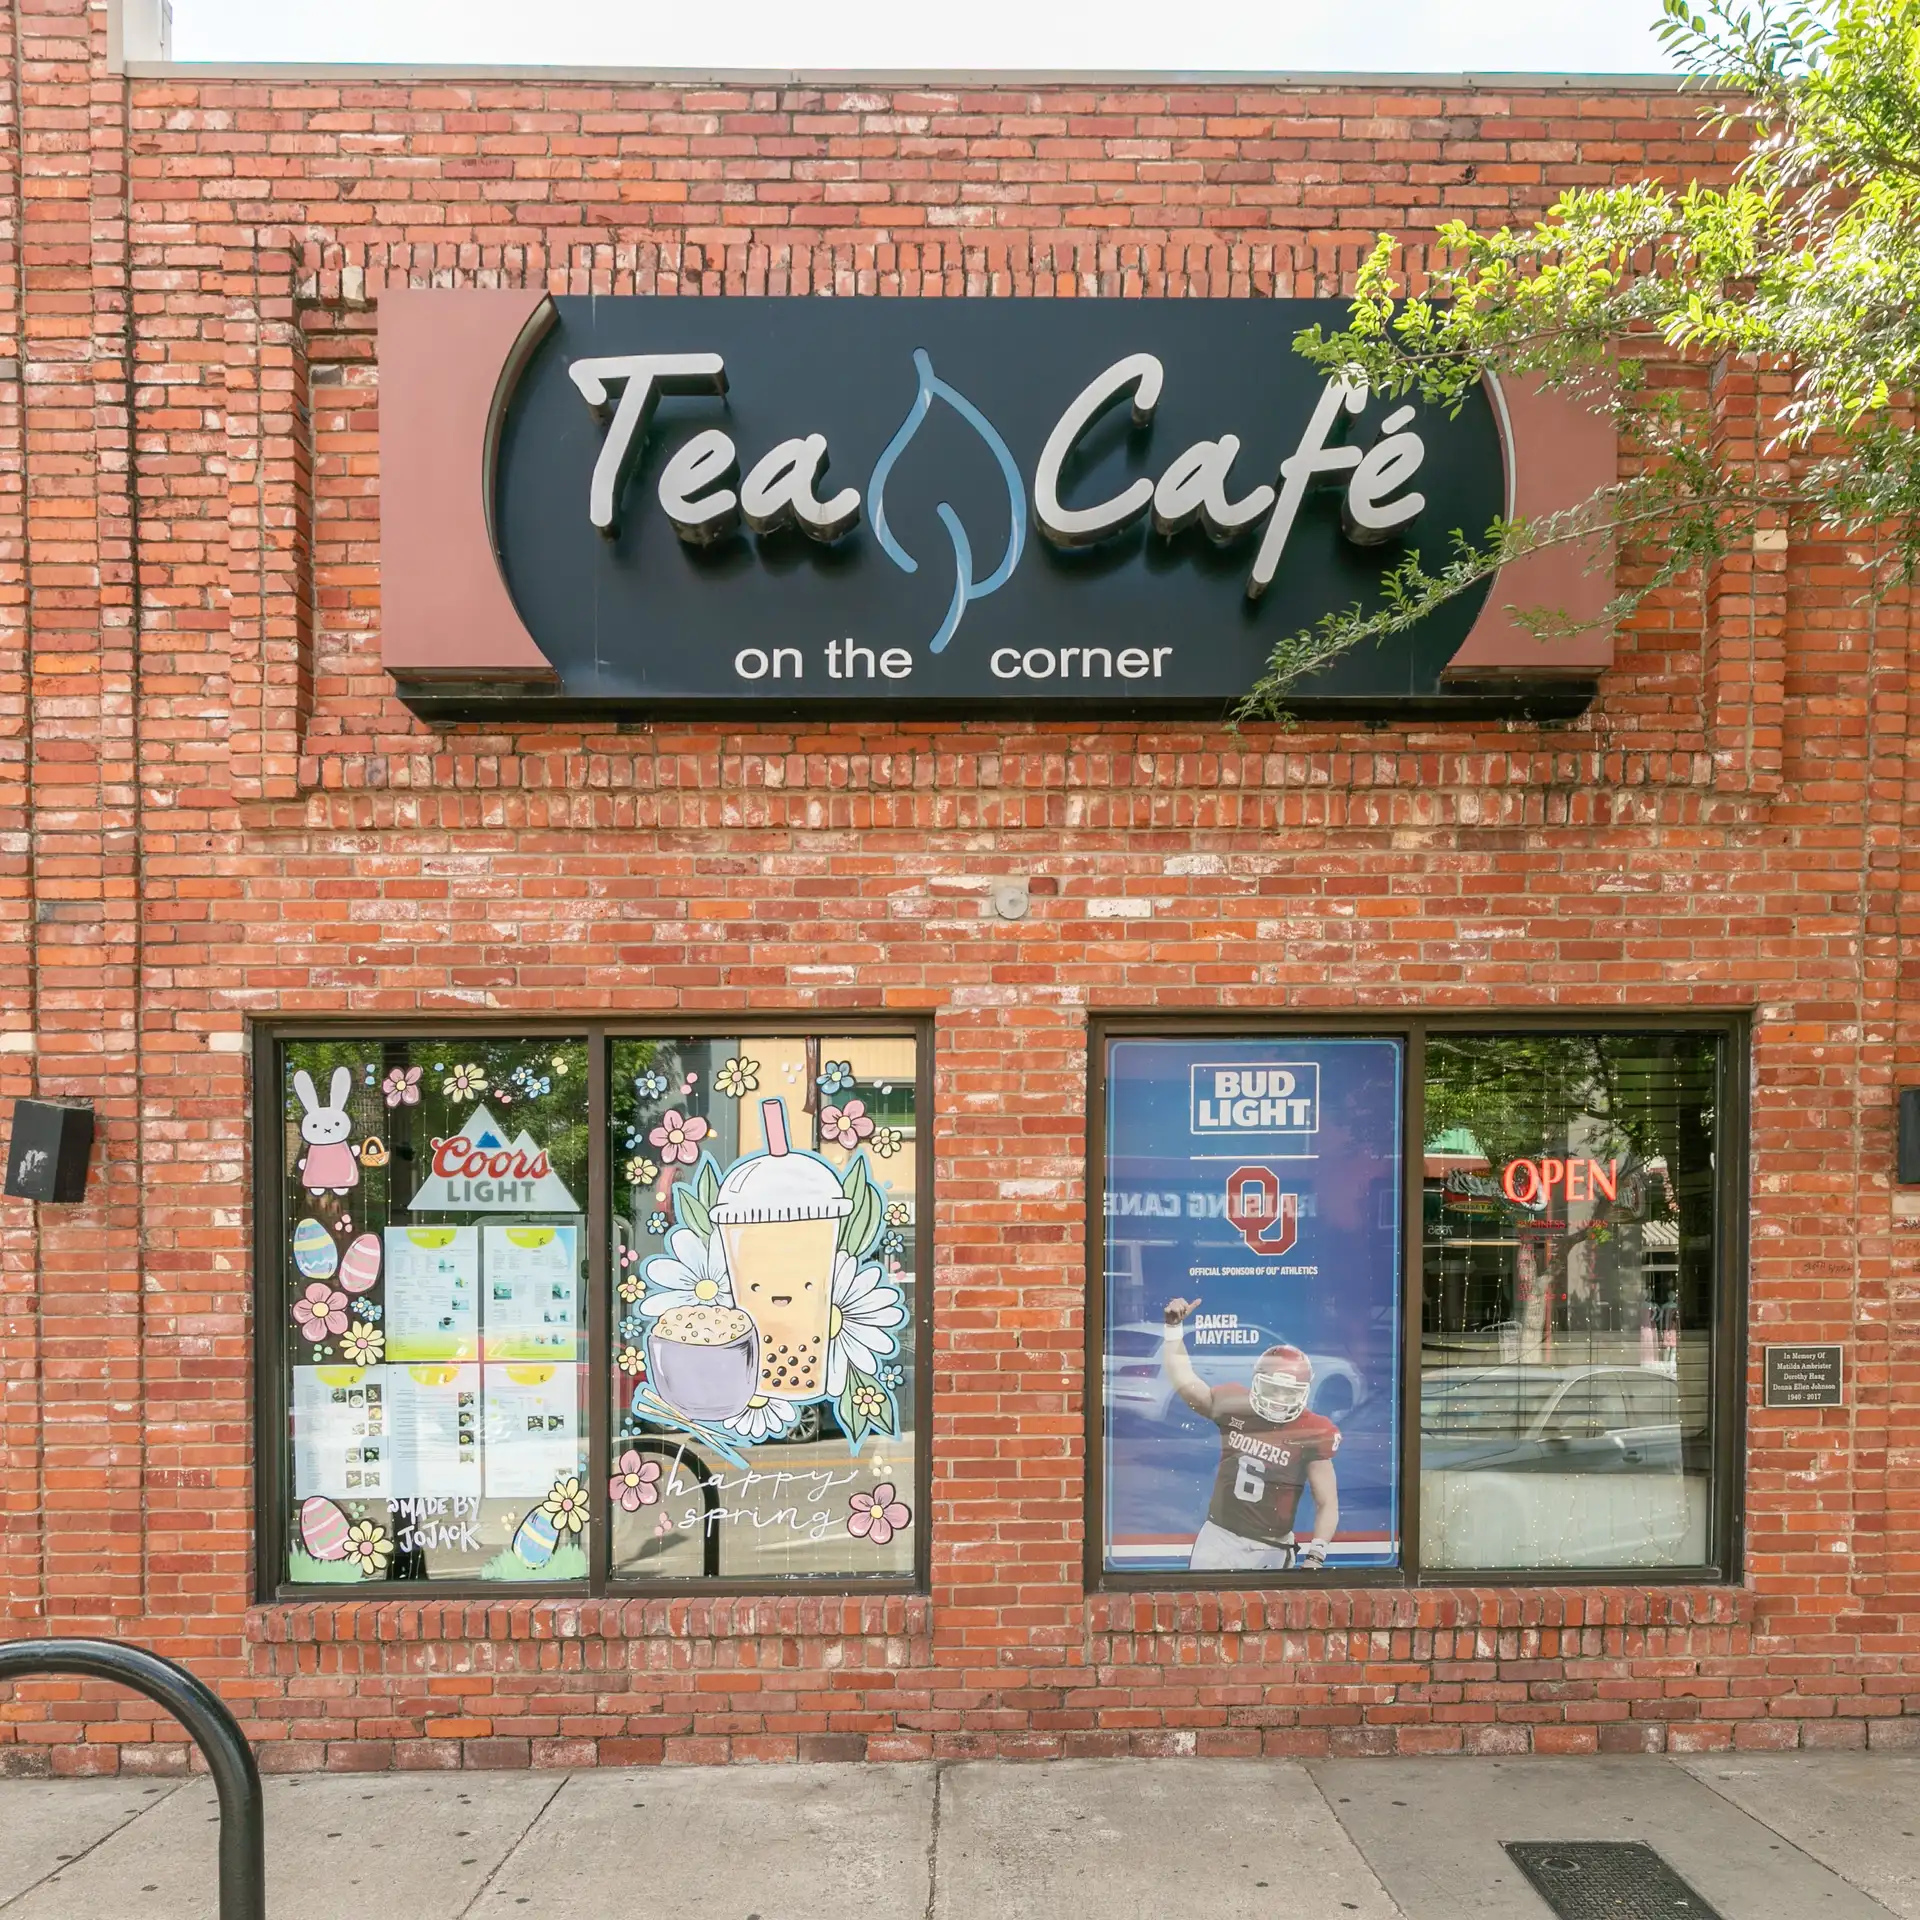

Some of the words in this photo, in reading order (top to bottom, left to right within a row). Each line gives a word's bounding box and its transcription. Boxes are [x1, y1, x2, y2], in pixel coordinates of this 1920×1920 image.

[568, 352, 861, 528] Tea
[1034, 352, 1426, 585] Café
[734, 647, 802, 680] on
[823, 638, 913, 680] the
[989, 646, 1174, 680] corner
[1214, 1070, 1296, 1099] BUD
[1198, 1099, 1311, 1127] LIGHT
[430, 1136, 552, 1180] Coors
[447, 1180, 537, 1203] LIGHT
[1502, 1157, 1618, 1202] OPEN
[1189, 1267, 1220, 1276] OFFICIAL
[1221, 1266, 1255, 1276] SPONSOR
[1256, 1266, 1265, 1275] OF
[1280, 1266, 1319, 1275] ATHLETICS
[1195, 1314, 1238, 1329] BAKER
[1195, 1329, 1260, 1344] MAYFIELD
[1228, 1430, 1291, 1467] SOONERS
[665, 1443, 860, 1502] happy
[1233, 1454, 1266, 1503] 6
[451, 1493, 481, 1522] BY
[677, 1505, 845, 1540] spring
